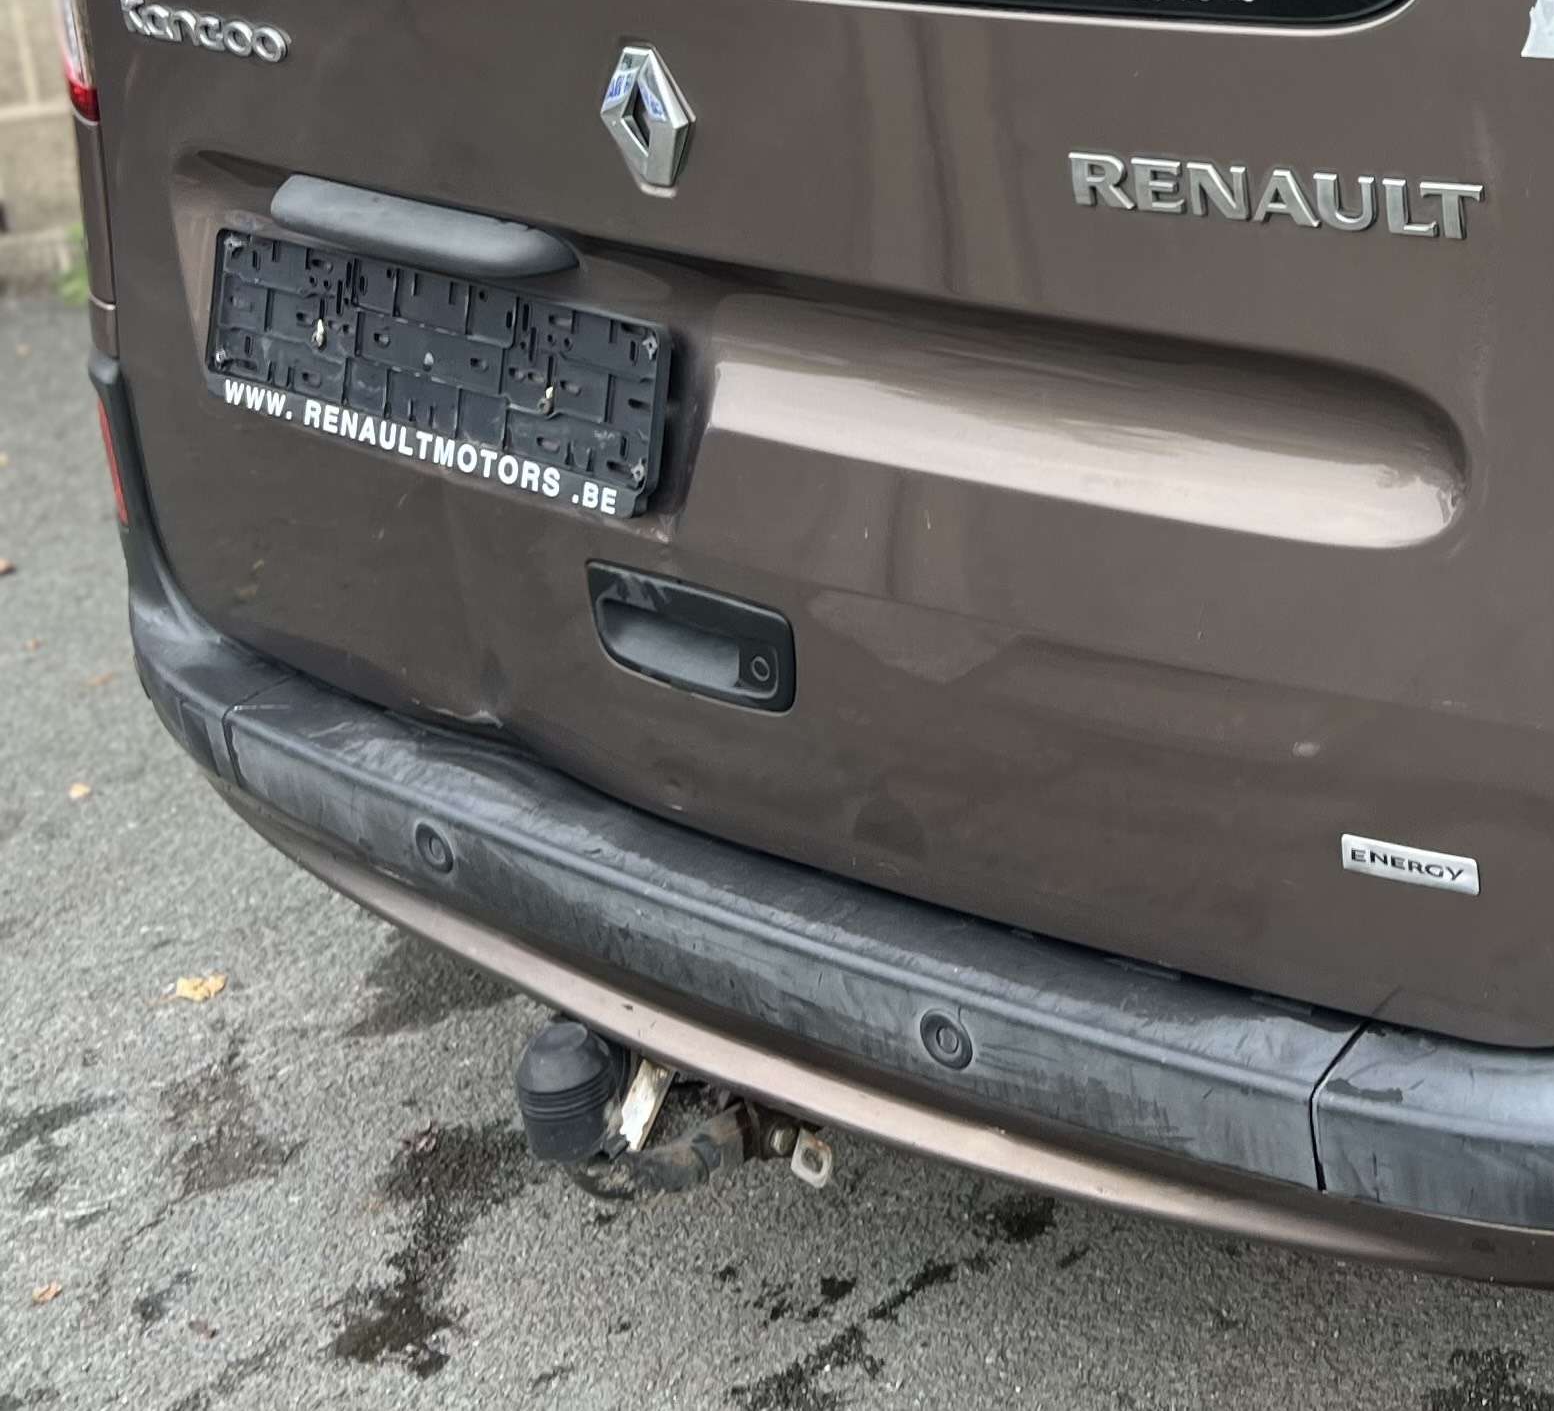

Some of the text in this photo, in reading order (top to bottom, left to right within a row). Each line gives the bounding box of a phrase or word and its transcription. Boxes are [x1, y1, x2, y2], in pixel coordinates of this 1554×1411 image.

[1068, 151, 1484, 239] RENAULT
[303, 398, 561, 498] RENAULTMOTORS
[571, 480, 618, 516] .BE
[1350, 848, 1465, 882] ENERGY
